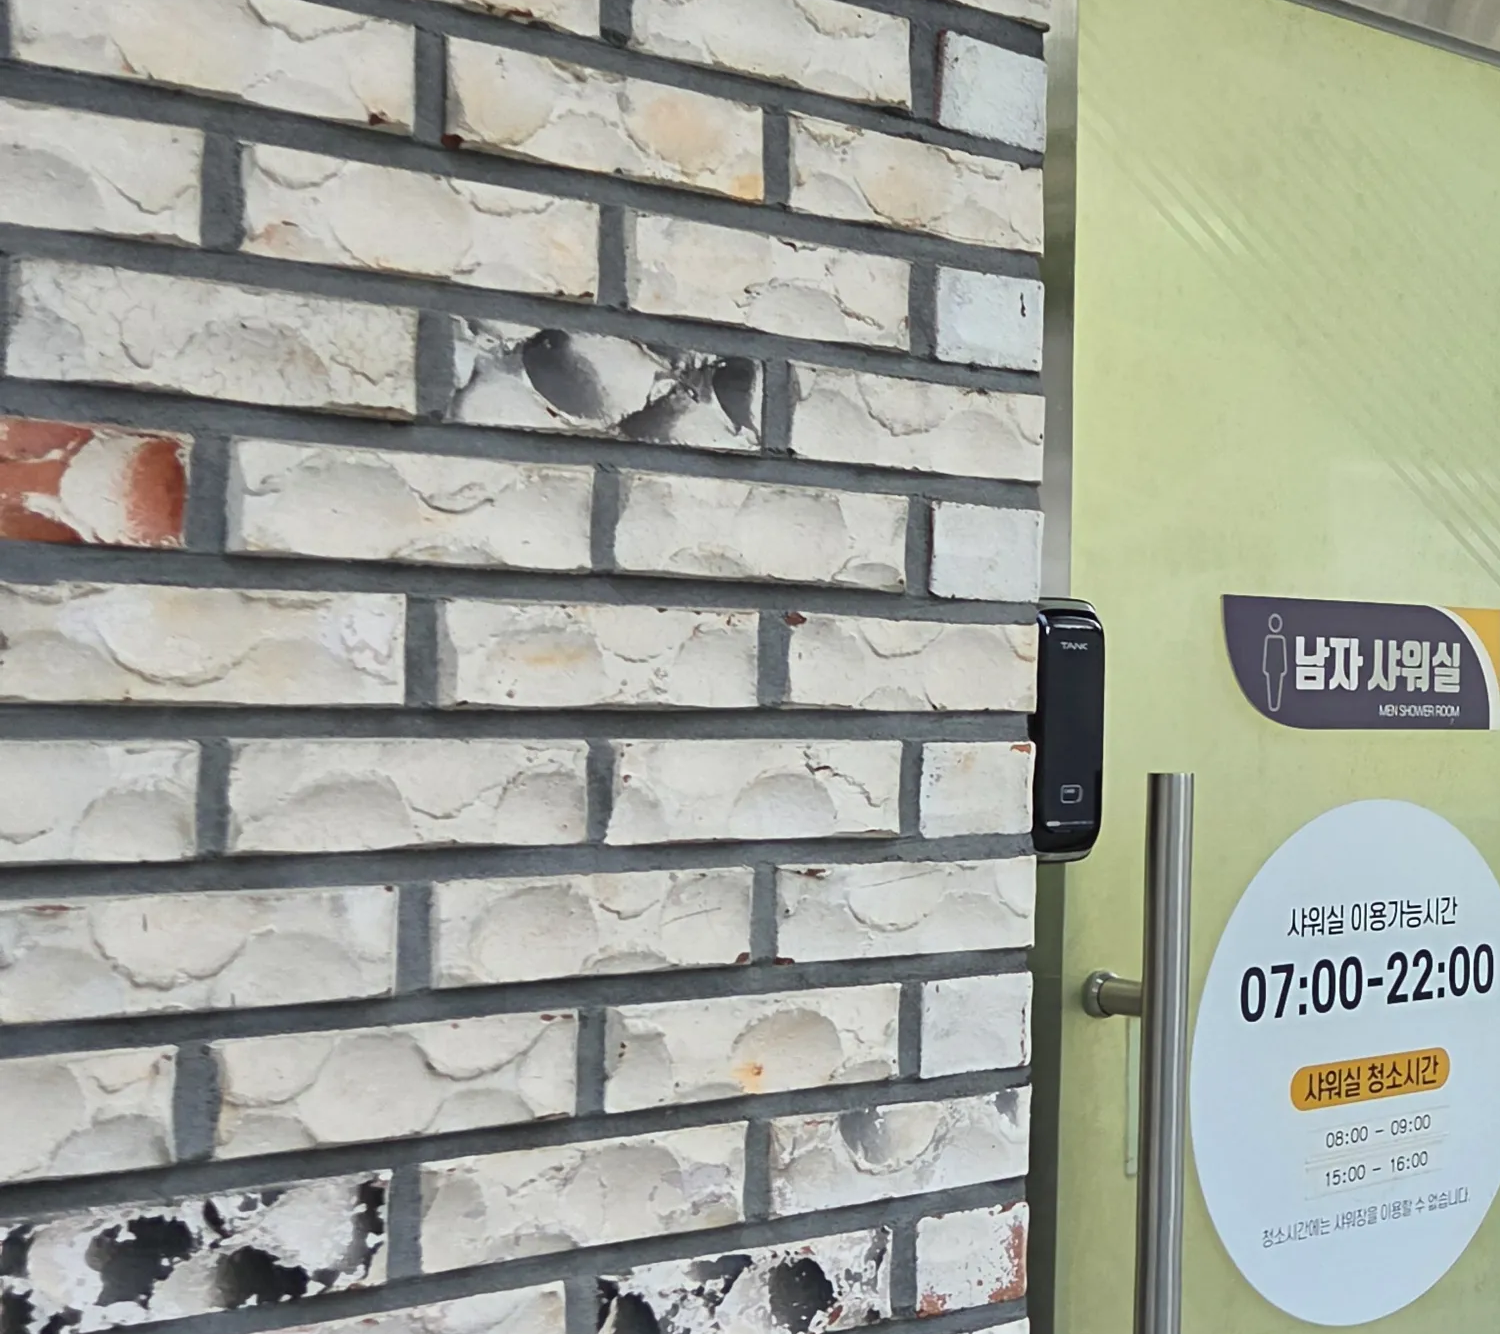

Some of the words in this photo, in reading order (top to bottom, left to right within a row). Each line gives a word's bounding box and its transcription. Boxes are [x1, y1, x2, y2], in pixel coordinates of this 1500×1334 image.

[1060, 641, 1089, 651] TANK
[1295, 636, 1364, 691] 남자
[1367, 638, 1461, 694] 샤워실
[1379, 704, 1397, 716] MEN
[1399, 704, 1435, 717] SHOWER
[1436, 704, 1459, 717] ROOM
[1287, 904, 1344, 938] 샤워실
[1351, 896, 1458, 932] 이용가능시간
[1240, 943, 1494, 1023] 07:00-22:00
[1303, 1065, 1361, 1102] 샤워실
[1367, 1054, 1439, 1094] 청소시간
[1325, 1125, 1369, 1149] 08:00
[1390, 1114, 1431, 1136] 09:00
[1325, 1163, 1366, 1188] 15:00
[1390, 1150, 1429, 1174] 16:00
[1262, 1218, 1331, 1249] 청소시간에는
[1333, 1203, 1378, 1232] 샤워장을
[1380, 1198, 1413, 1221] 이용할
[1415, 1196, 1426, 1214] 수
